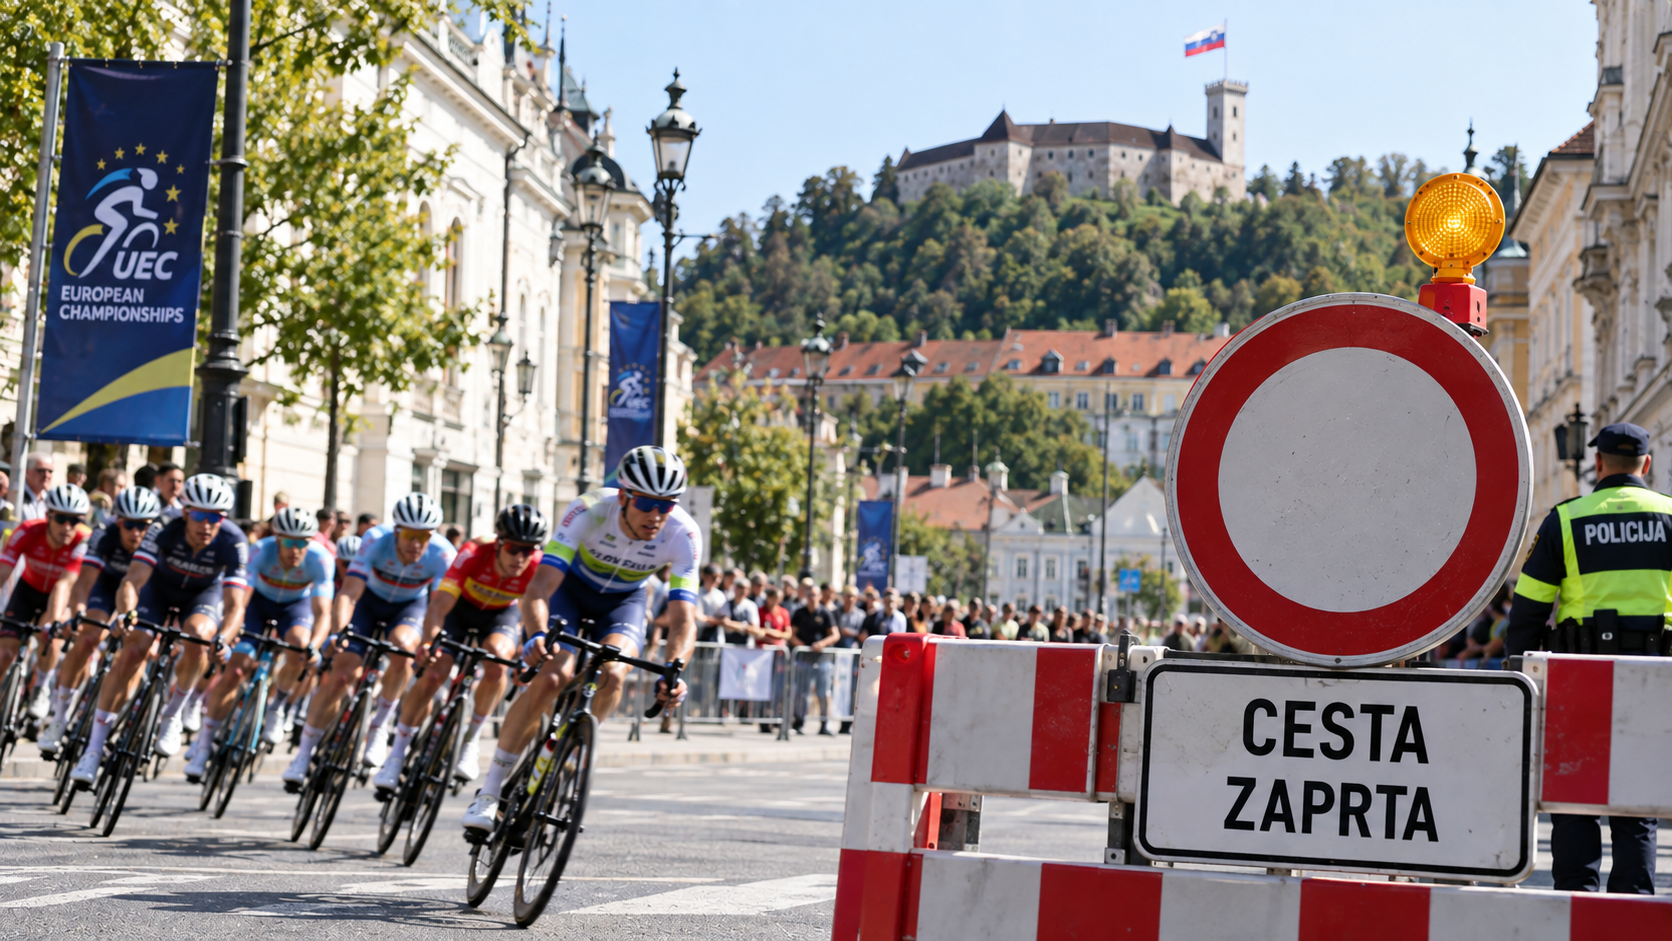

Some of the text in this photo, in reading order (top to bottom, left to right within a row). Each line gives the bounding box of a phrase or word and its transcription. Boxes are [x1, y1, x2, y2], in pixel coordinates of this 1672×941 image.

[113, 251, 178, 280] UEC
[60, 285, 144, 303] EUROPEAN
[59, 304, 184, 323] CHAMPIONSHIPS
[1584, 520, 1667, 546] POLICIJA
[1243, 698, 1430, 764] CESTA
[1224, 776, 1439, 842] ZAPRTA
